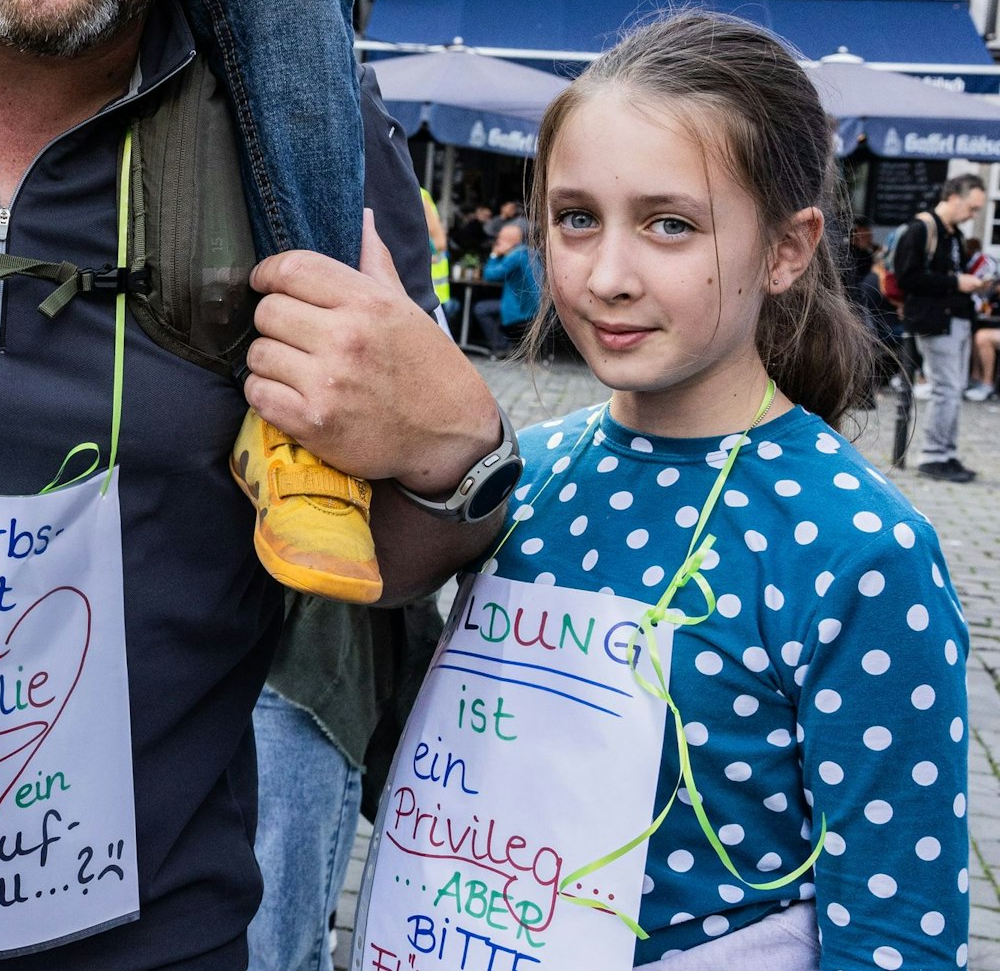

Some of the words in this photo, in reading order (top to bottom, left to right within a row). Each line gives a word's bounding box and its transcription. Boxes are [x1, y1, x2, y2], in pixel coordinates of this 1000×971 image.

[464, 595, 645, 670] LDUNG
[457, 684, 518, 742] ist
[15, 771, 71, 809] ein
[413, 736, 479, 795] ein
